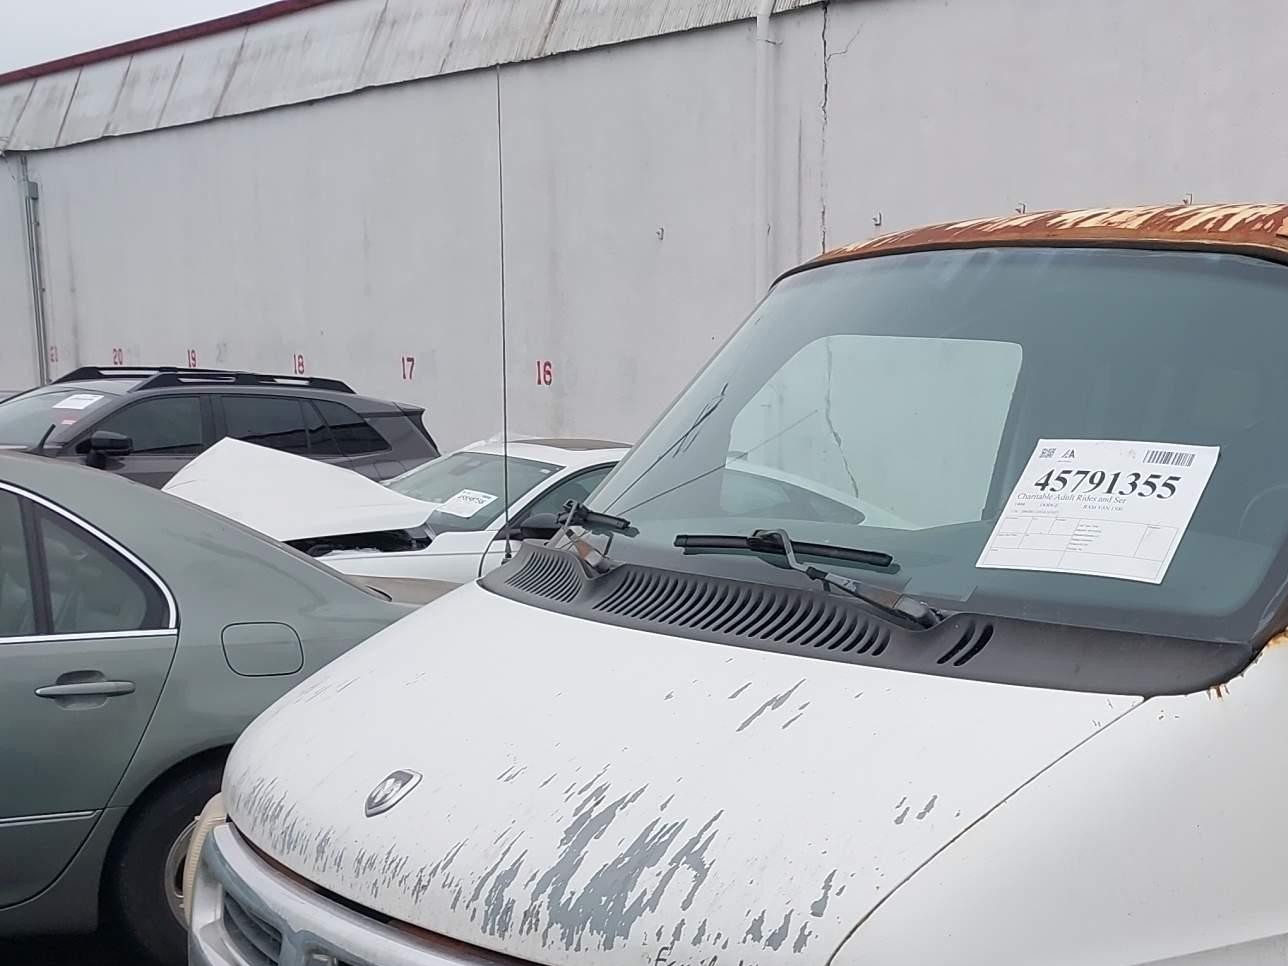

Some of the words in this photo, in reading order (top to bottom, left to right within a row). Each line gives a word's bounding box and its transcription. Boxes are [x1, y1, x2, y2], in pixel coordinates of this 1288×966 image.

[112, 347, 124, 366] 20
[186, 349, 198, 368] 19
[292, 353, 305, 375] 18
[401, 356, 416, 380] 17
[536, 360, 553, 386] 16
[1034, 468, 1183, 500] 45791355
[1017, 492, 1054, 501] Charitable
[1055, 494, 1075, 502] Adult
[1076, 494, 1097, 502] Rides
[1097, 495, 1112, 503] and
